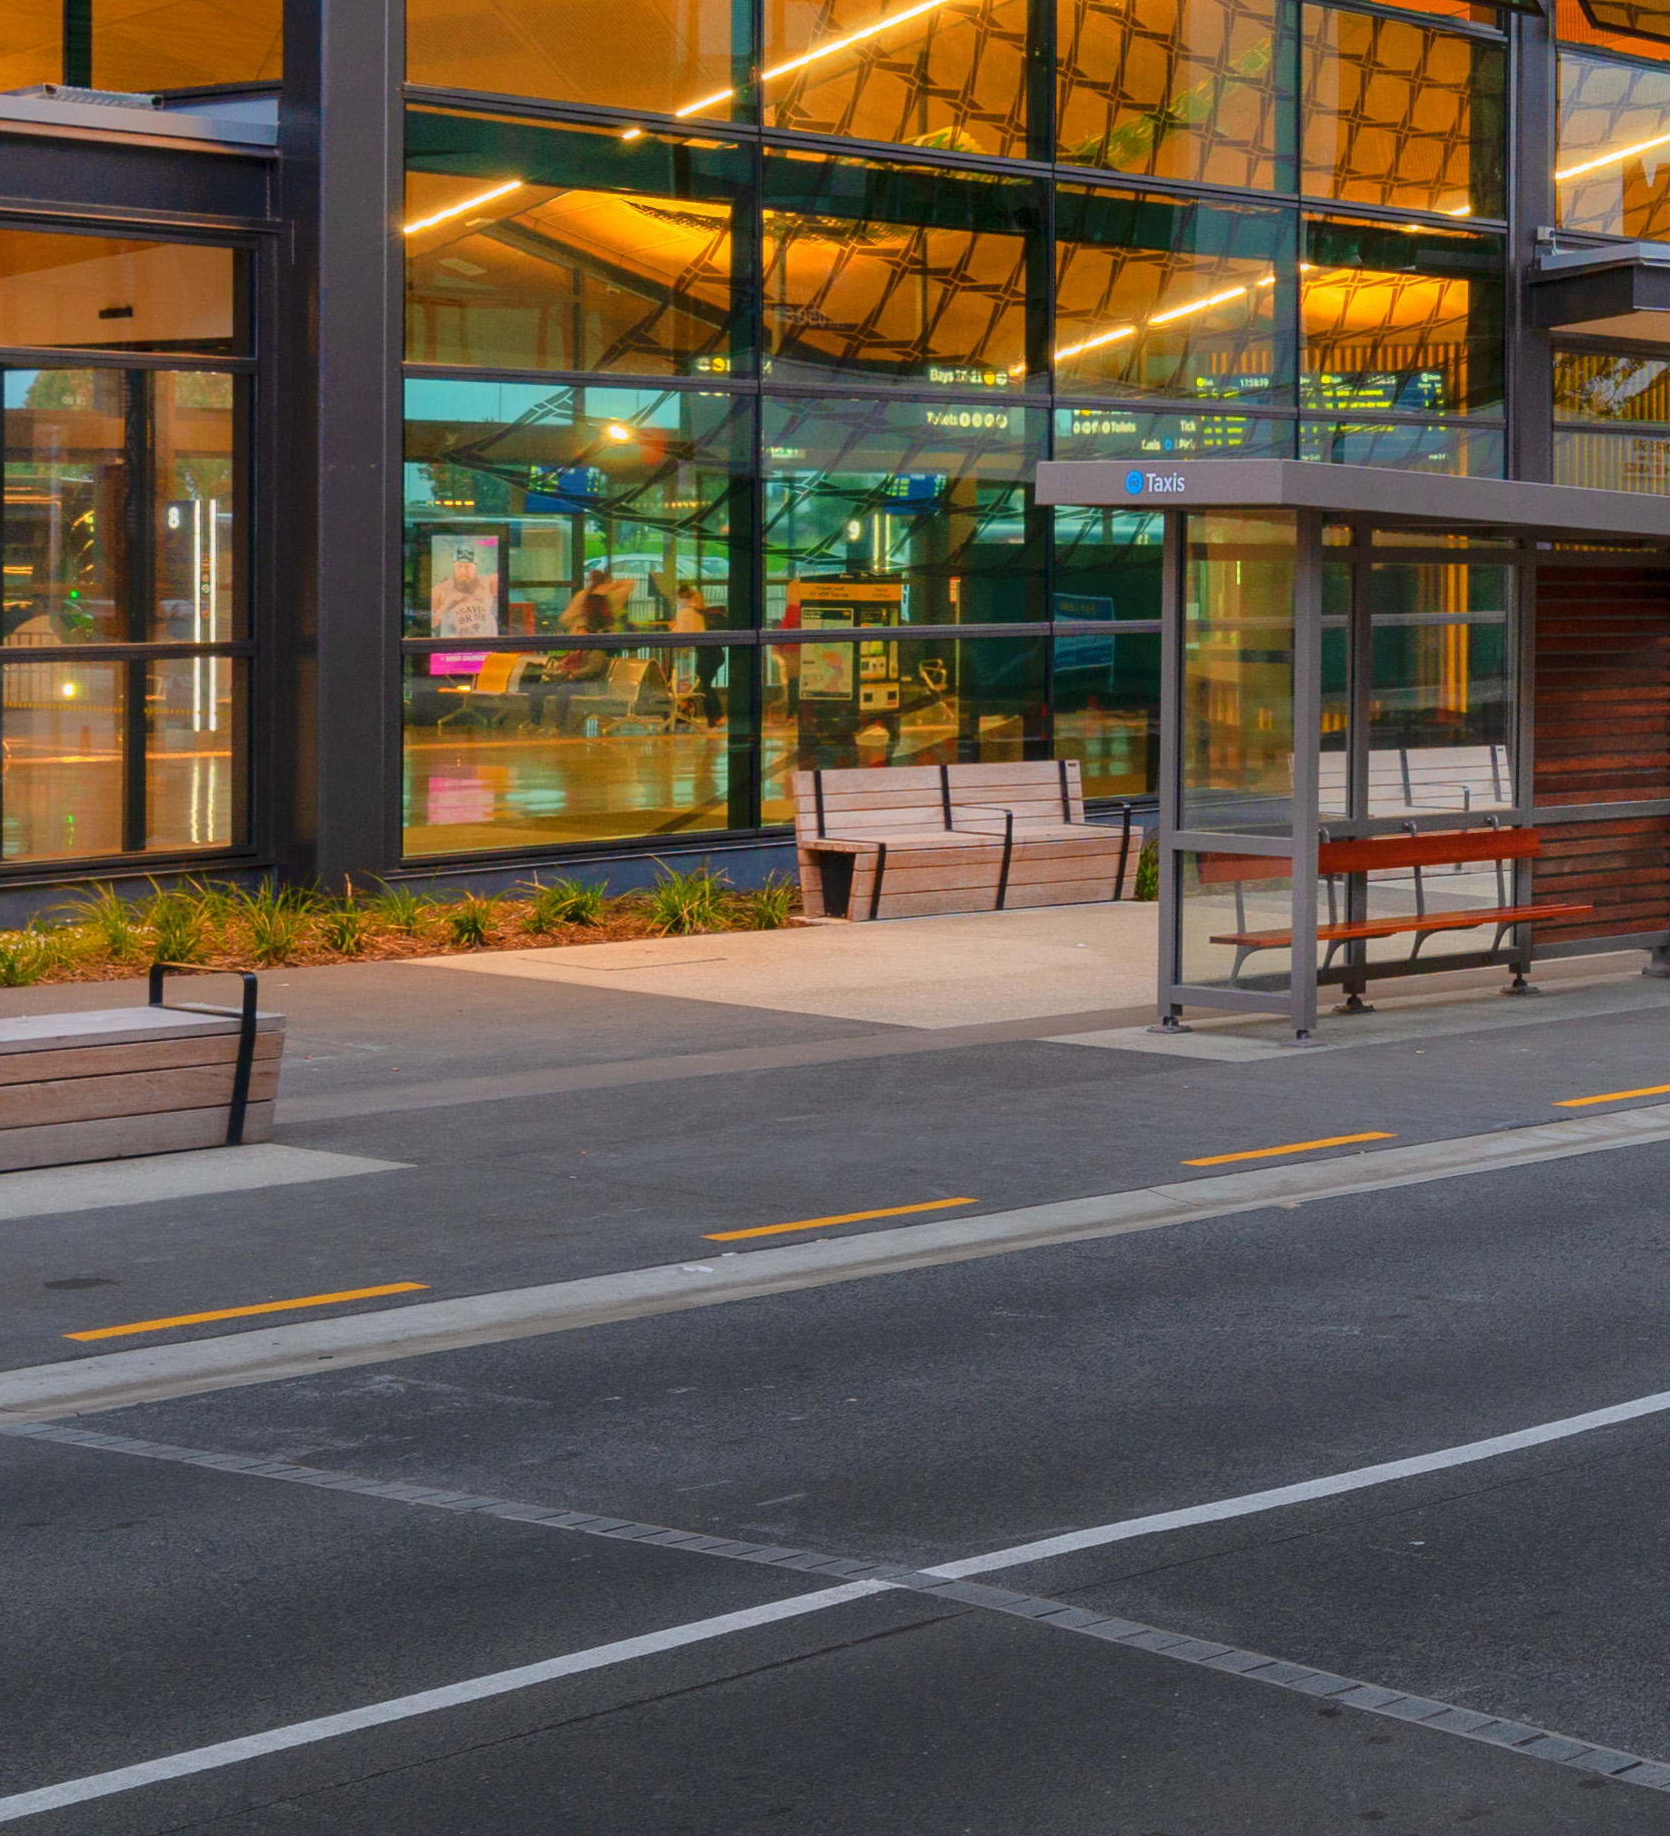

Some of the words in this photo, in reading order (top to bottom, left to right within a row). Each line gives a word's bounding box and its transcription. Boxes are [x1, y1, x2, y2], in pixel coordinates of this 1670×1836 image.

[930, 368, 954, 384] Bays
[1146, 472, 1186, 493] Taxis
[168, 506, 180, 529] 8
[848, 520, 861, 541] 9
[459, 614, 473, 625] OR
